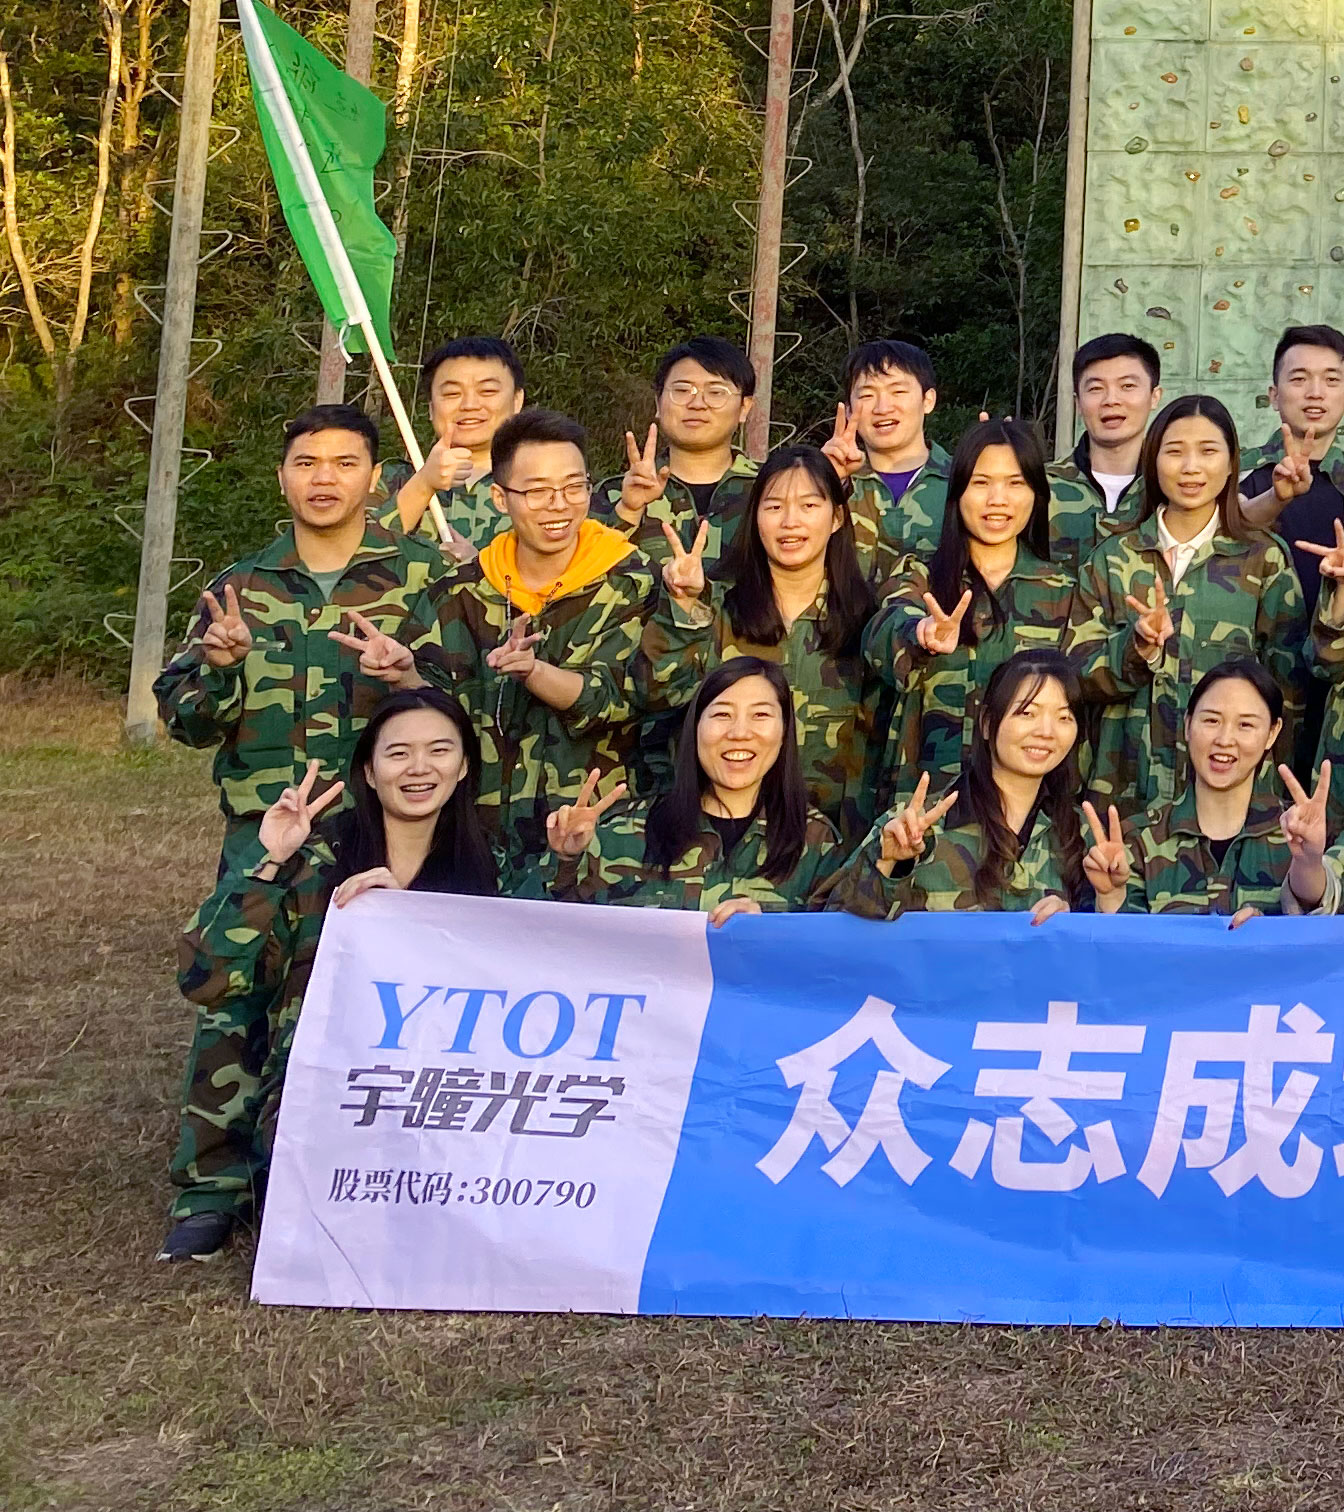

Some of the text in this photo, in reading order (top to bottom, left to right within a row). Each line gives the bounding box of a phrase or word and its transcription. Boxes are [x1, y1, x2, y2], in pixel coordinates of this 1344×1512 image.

[370, 980, 646, 1062] YTOT
[339, 1064, 626, 1139] 宇瞳光学
